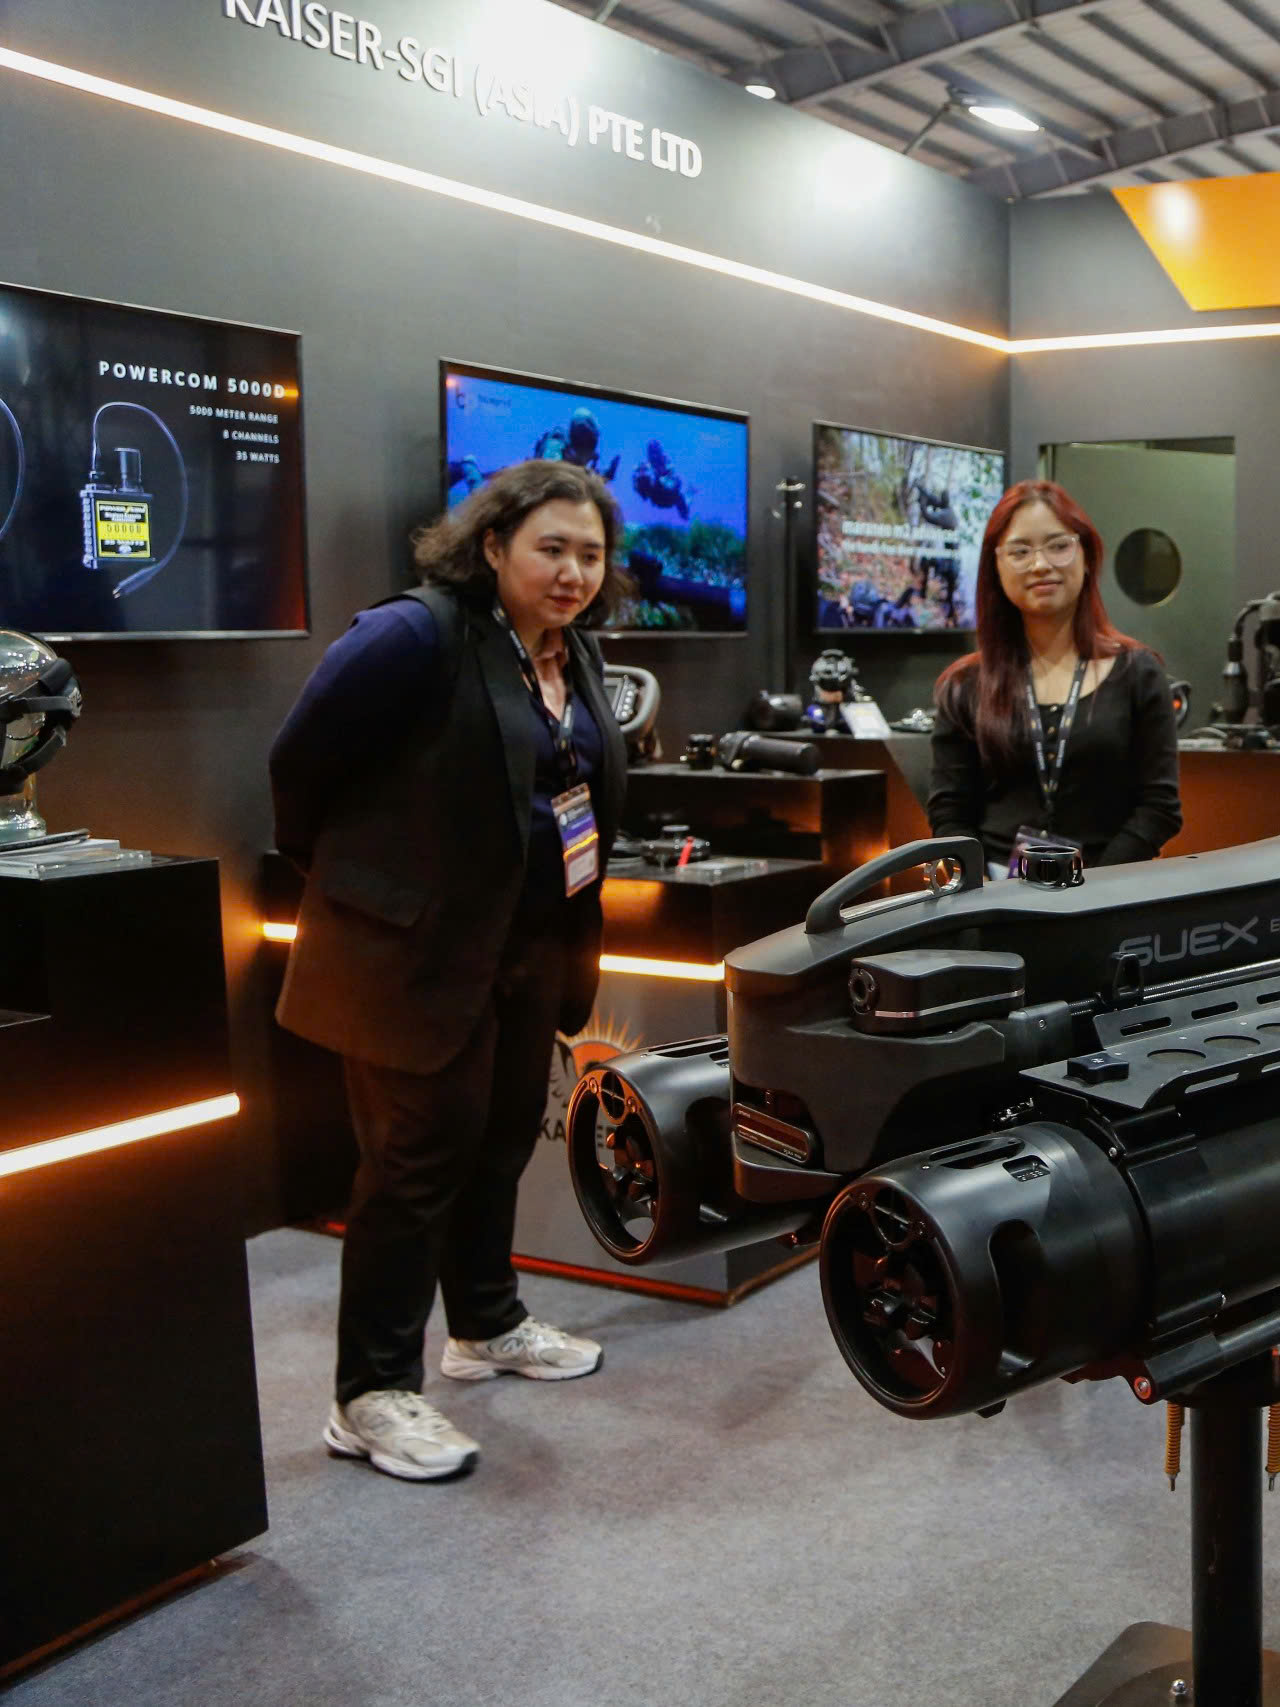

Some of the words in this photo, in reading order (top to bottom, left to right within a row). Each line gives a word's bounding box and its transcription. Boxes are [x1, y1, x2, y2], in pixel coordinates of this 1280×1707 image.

[589, 104, 645, 161] PTE
[651, 127, 702, 178] LTD
[99, 360, 218, 391] POWERCOM
[227, 378, 286, 399] 5000D
[189, 404, 213, 417] 5000
[215, 407, 246, 420] METER
[248, 411, 278, 424] RANGE
[231, 430, 280, 444] CHANNELS
[249, 451, 280, 464] WATTS
[1119, 916, 1258, 967] SUEX
